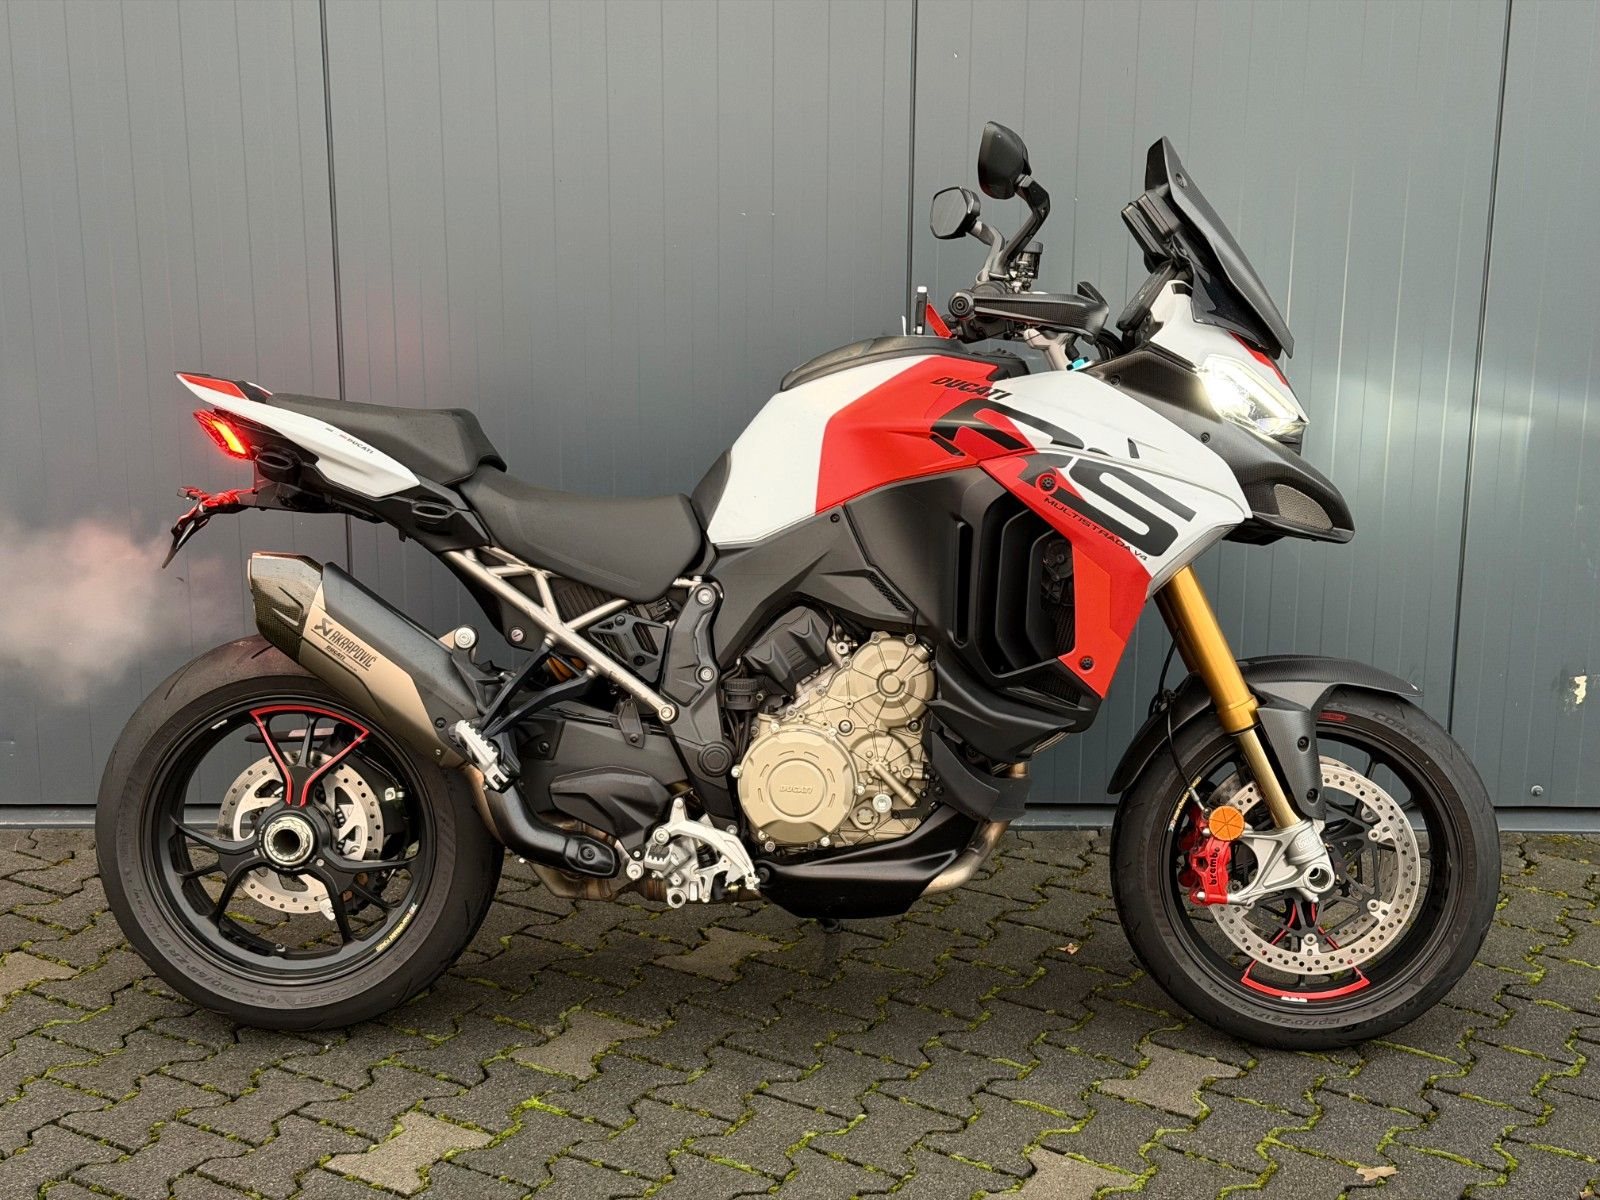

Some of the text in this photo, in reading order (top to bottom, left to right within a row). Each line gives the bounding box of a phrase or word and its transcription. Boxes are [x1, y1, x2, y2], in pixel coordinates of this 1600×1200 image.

[929, 376, 1014, 401] DUCATI
[347, 438, 374, 454] DUCATI
[1044, 497, 1149, 562] MULTISTRADA V4
[325, 645, 346, 661] DUCATI
[780, 784, 814, 795] DUCATI
[1208, 846, 1221, 885] brembo
